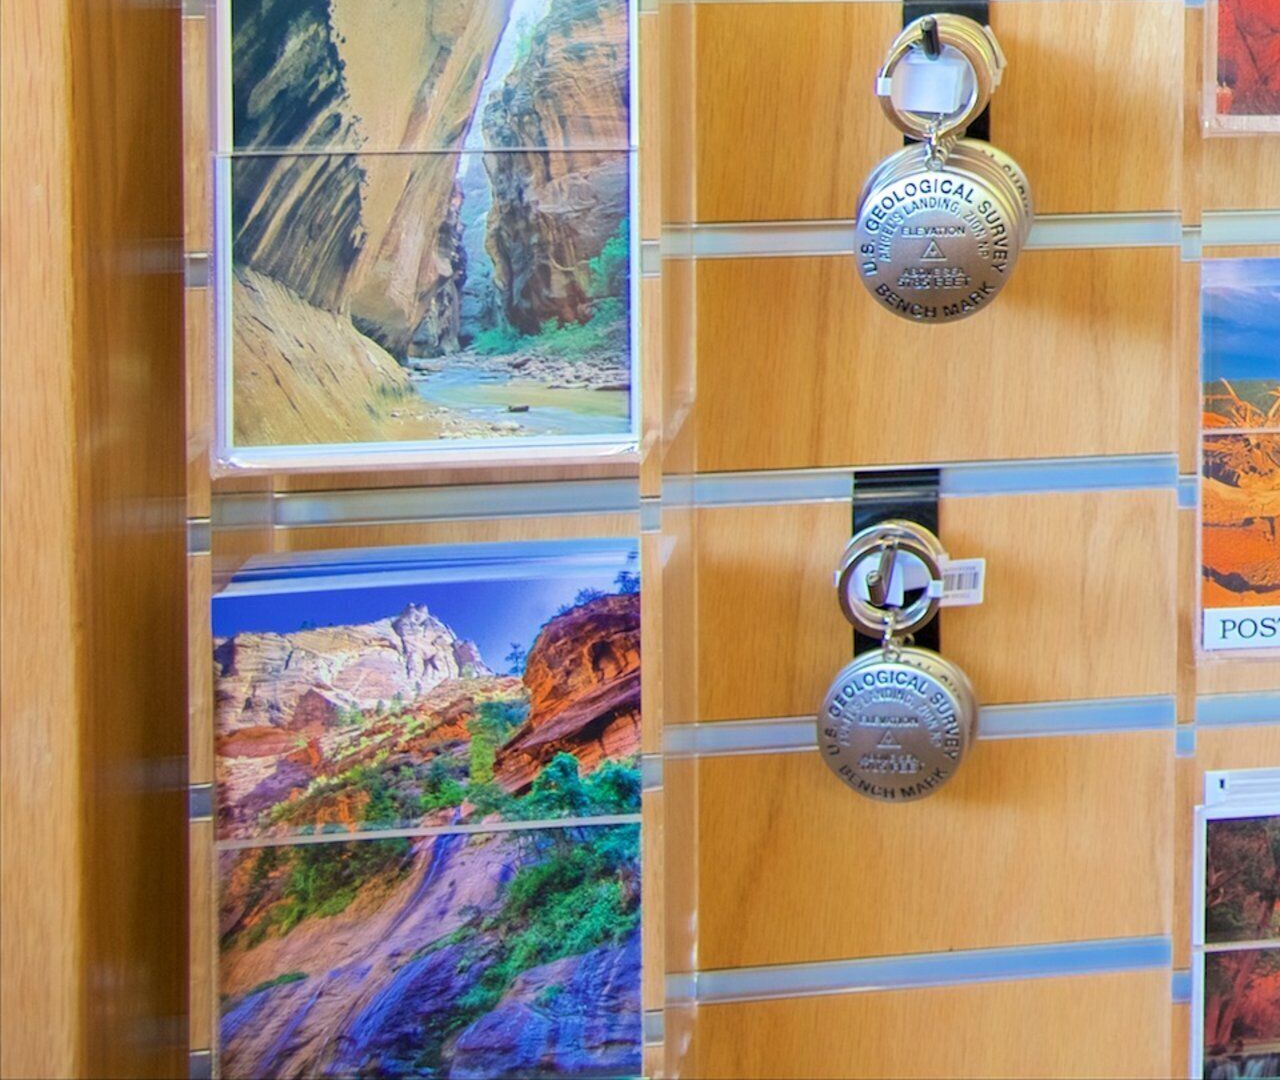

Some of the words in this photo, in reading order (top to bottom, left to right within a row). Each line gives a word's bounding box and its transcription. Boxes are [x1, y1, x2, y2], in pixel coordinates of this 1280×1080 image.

[866, 179, 975, 235] GEOLOGICAL
[977, 200, 1009, 274] SURVEY
[901, 226, 965, 236] ELEVATION
[875, 282, 937, 317] BENCH
[944, 282, 994, 317] MARK
[829, 670, 928, 718] GEOLOGICAL
[930, 692, 960, 760] SURVEY
[900, 767, 948, 798] MARK
